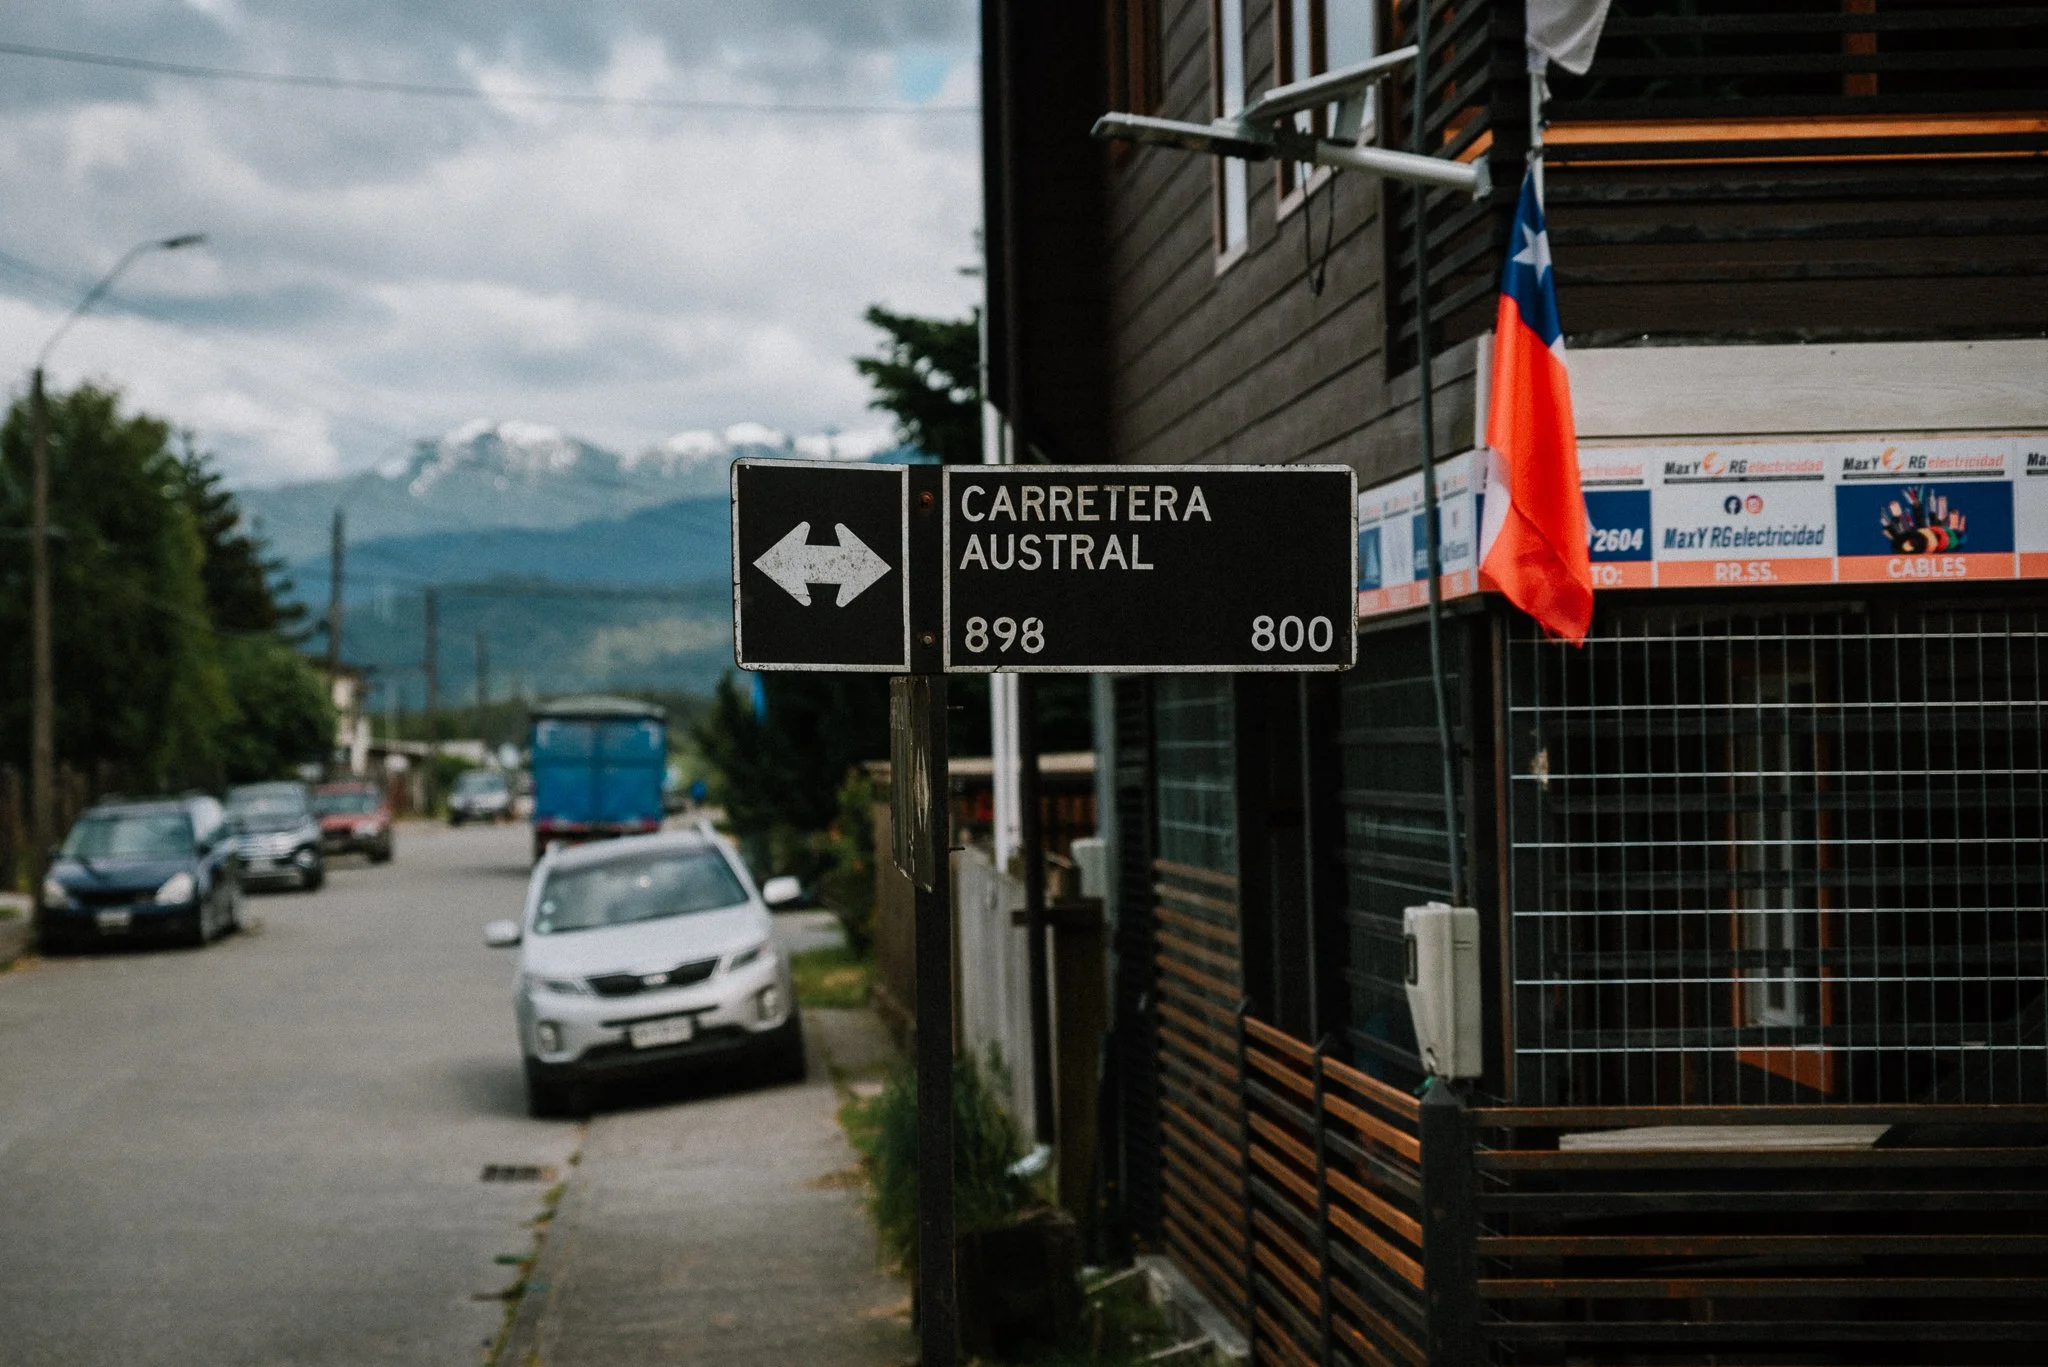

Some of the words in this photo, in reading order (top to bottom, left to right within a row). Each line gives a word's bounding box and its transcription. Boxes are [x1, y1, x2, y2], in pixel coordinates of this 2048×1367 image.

[2027, 453, 2048, 466] Ma
[961, 485, 1212, 522] CARRETERA
[959, 534, 1154, 571] AUSTRAL
[1594, 528, 1644, 552] 2604
[1887, 557, 1967, 577] CABLES
[965, 616, 1045, 653] 898
[1251, 615, 1334, 653] 800
